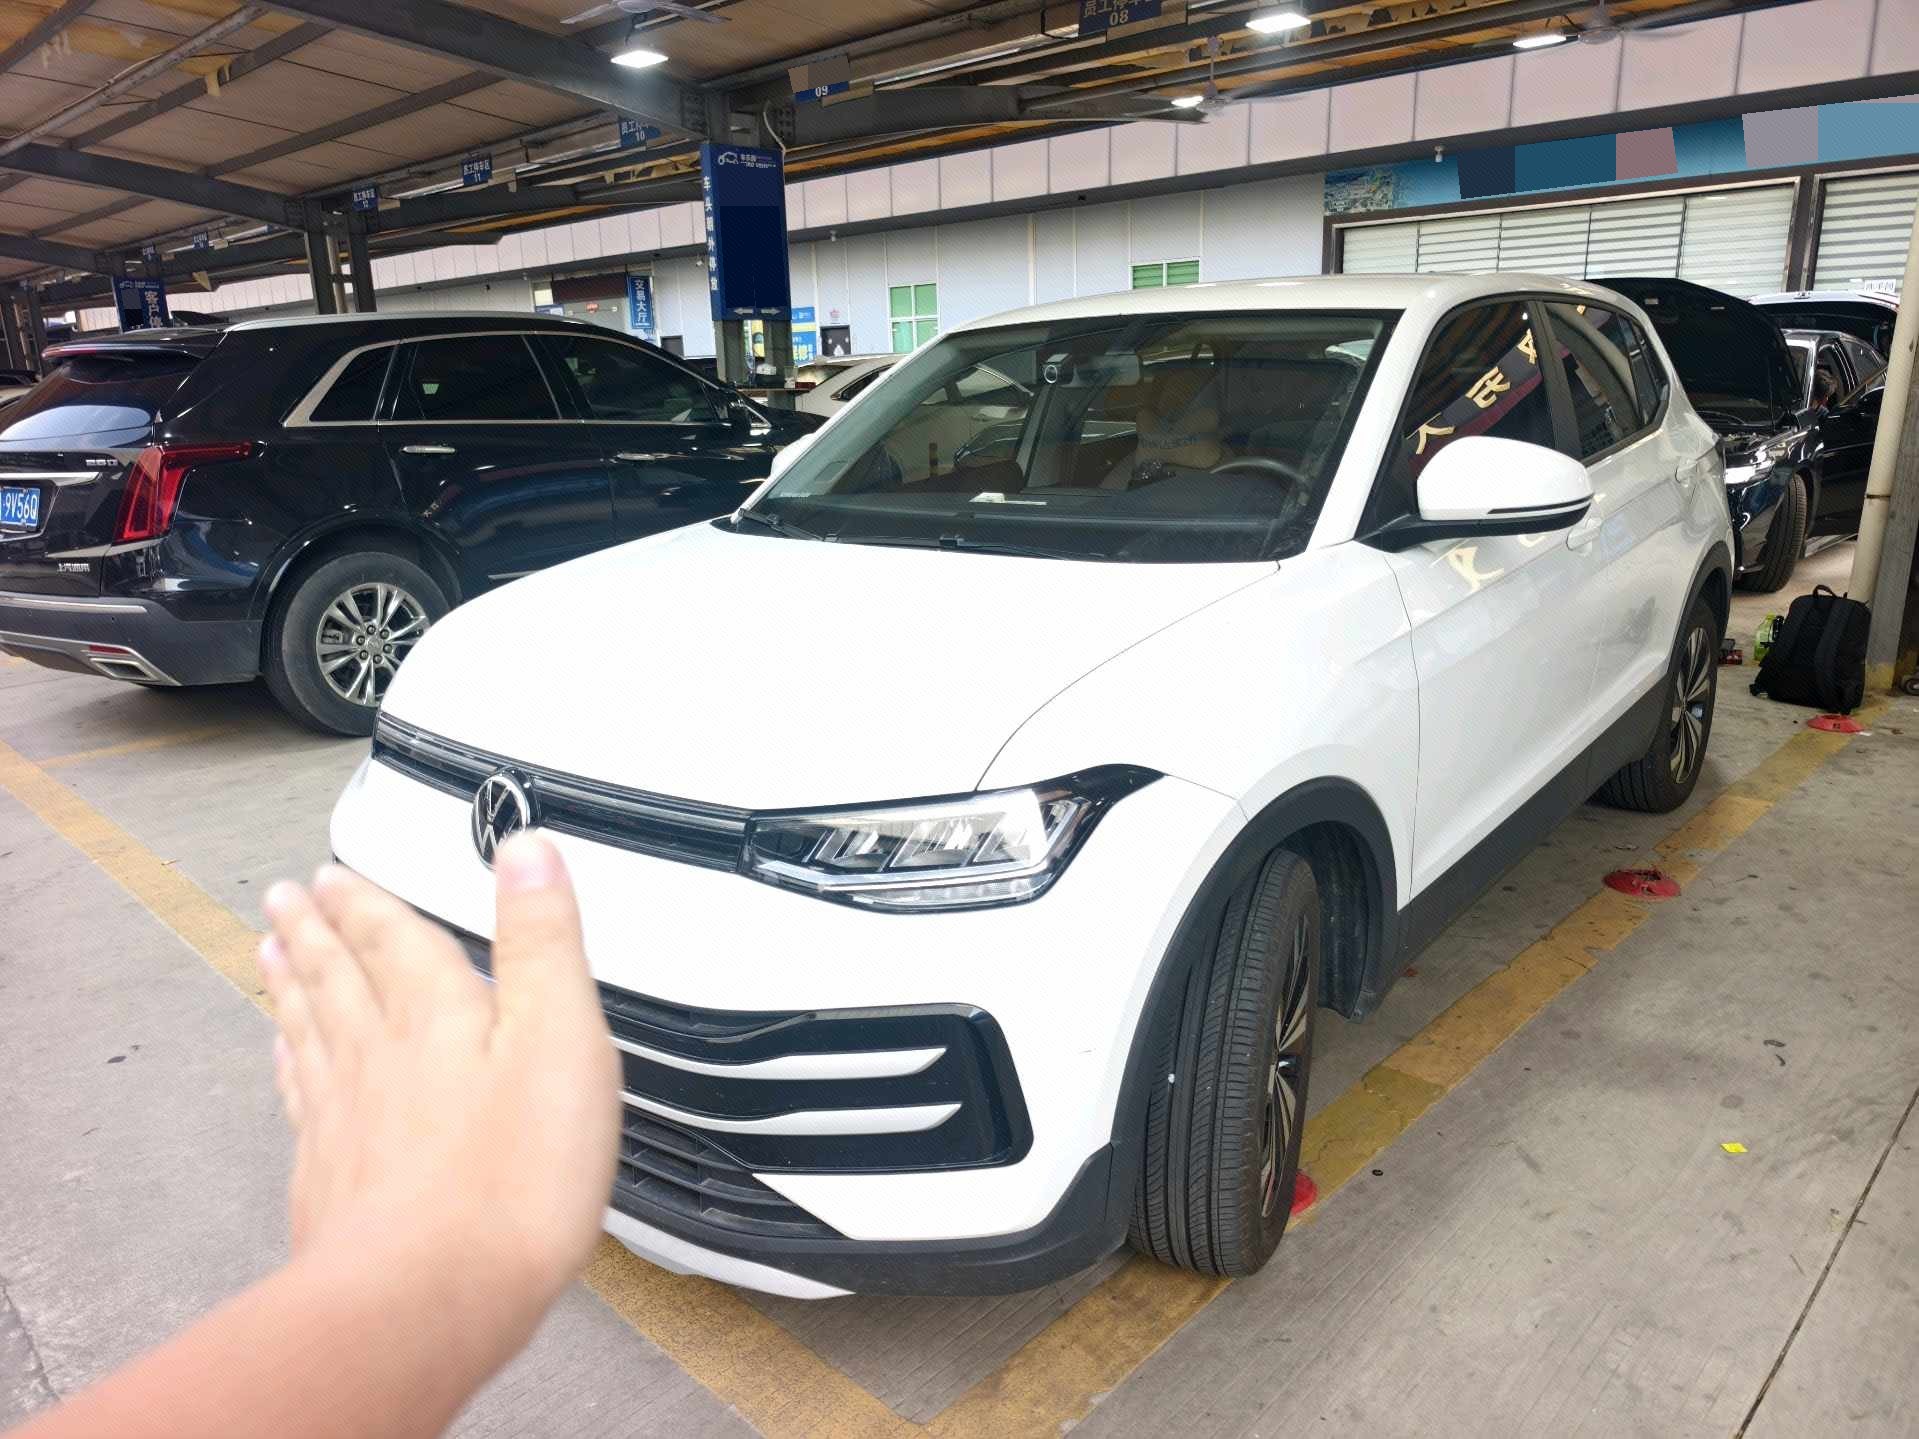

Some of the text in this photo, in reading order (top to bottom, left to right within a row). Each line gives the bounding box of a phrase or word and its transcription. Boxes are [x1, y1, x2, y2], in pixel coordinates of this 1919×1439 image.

[1110, 9, 1128, 26] 08
[815, 86, 829, 97] 09
[634, 279, 648, 323] 交易大厅
